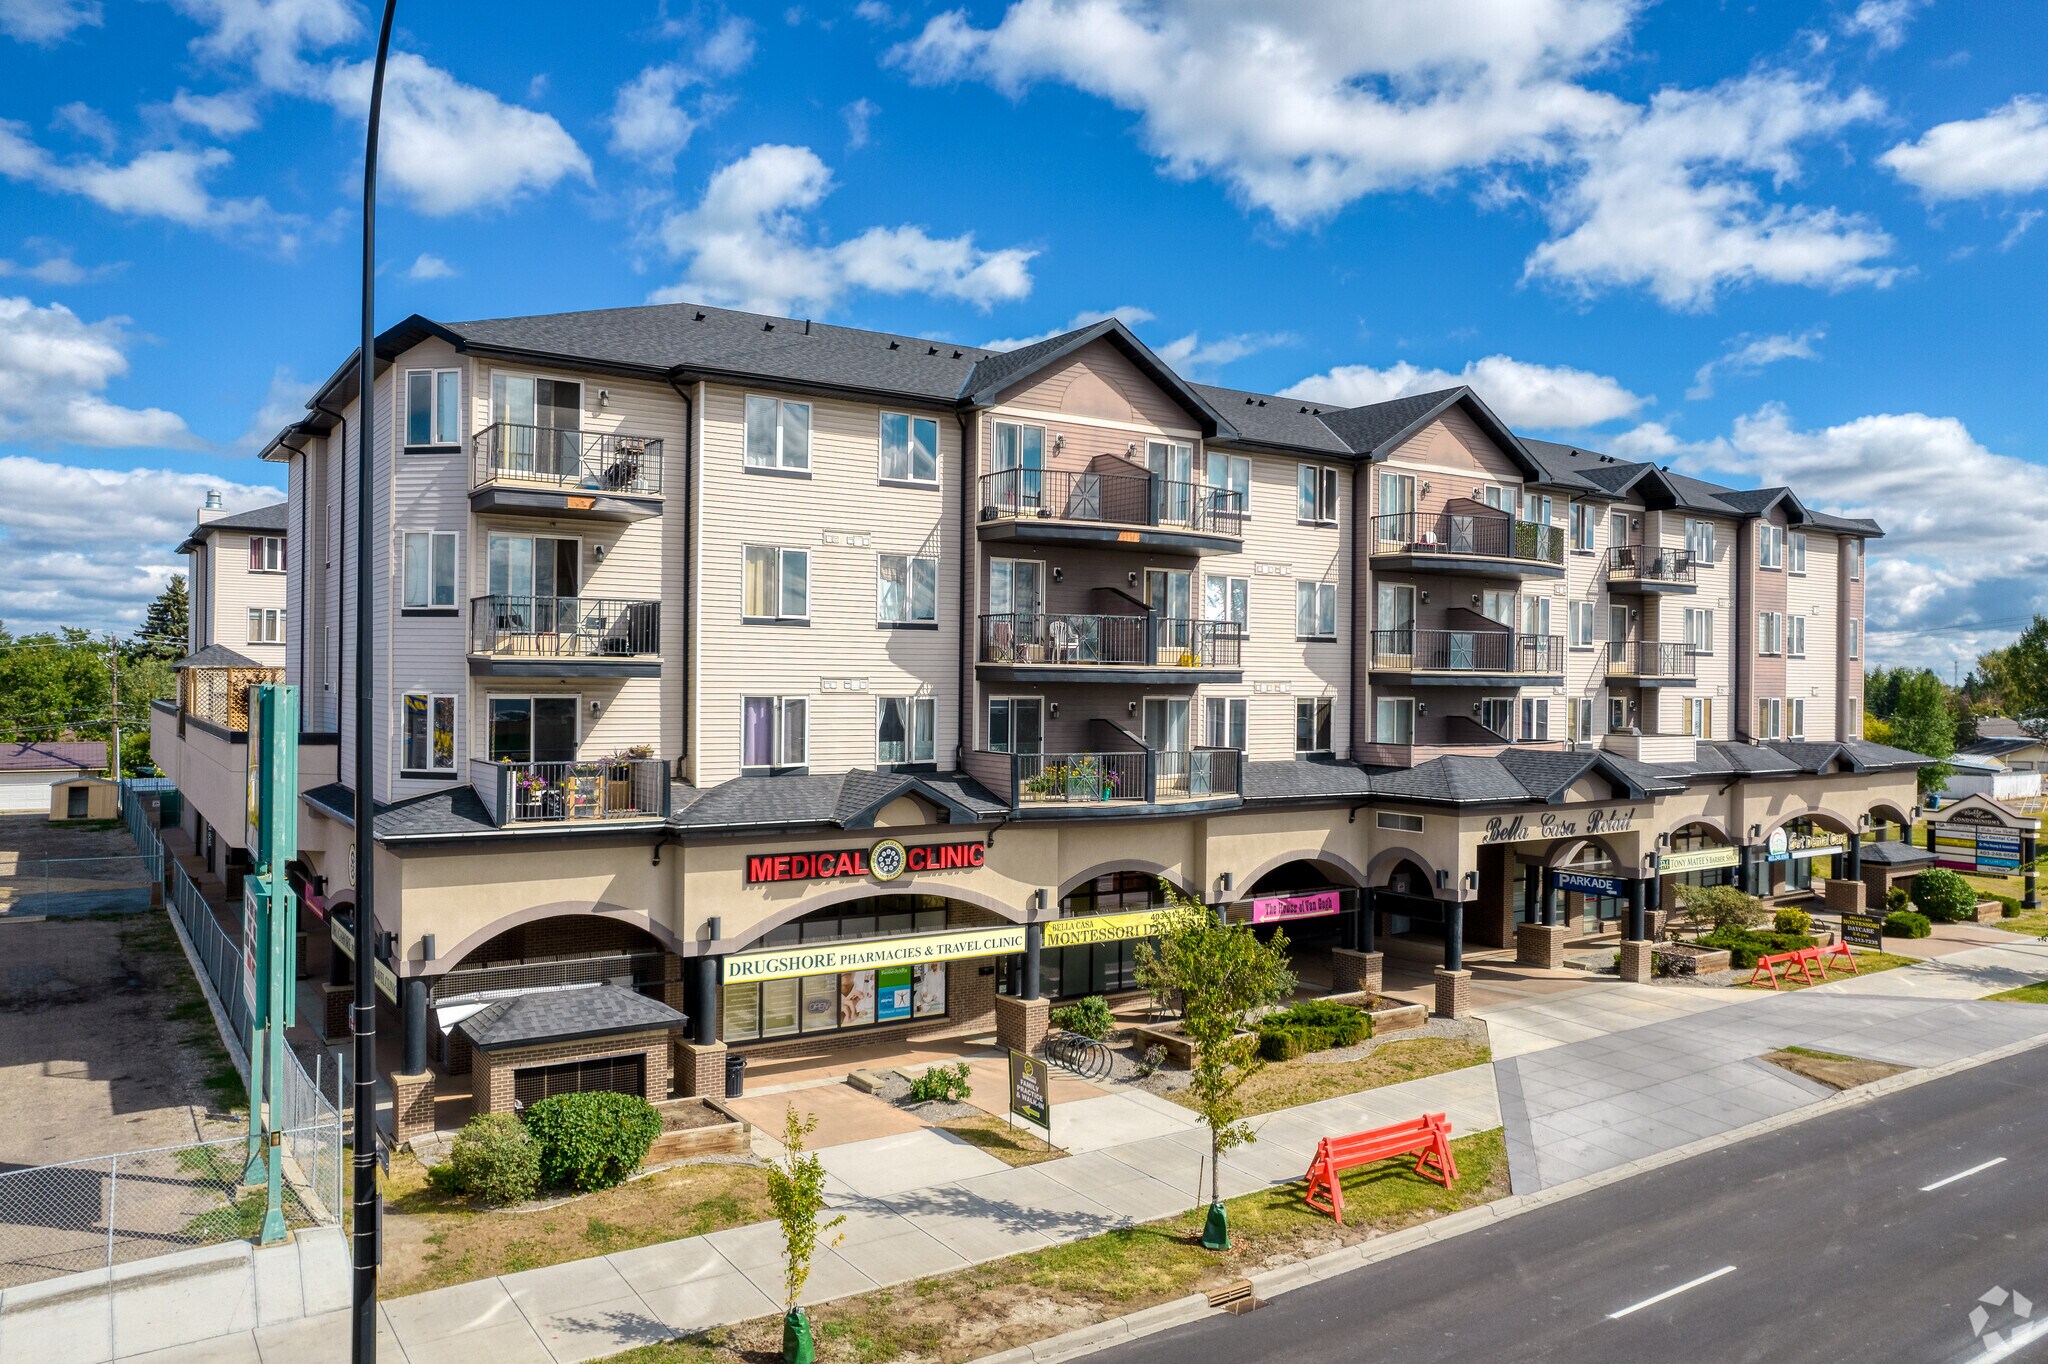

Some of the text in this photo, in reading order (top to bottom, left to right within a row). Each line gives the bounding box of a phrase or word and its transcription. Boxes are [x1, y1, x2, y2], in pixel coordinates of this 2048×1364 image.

[1482, 807, 1636, 843] Bella Casa Retail
[1953, 817, 2000, 825] CONDOMINIUMS
[1805, 833, 1830, 849] Dental
[1830, 833, 1847, 846] Care
[750, 852, 869, 881] MEDICAL
[907, 843, 984, 871] CLINIC
[1671, 858, 1686, 868] TONY
[1559, 873, 1613, 890] PARKADE
[1265, 897, 1333, 915] The House of Van Gogh
[1052, 921, 1075, 932] BELLA
[1076, 920, 1094, 930] CASA
[1843, 919, 1880, 929] MONTESSORI
[1847, 925, 1875, 934] DAYCARE
[1047, 924, 1139, 946] MONTESSORI
[729, 936, 1023, 977] DRUGSHORE PHARMACIES & TRAVEL CLINIC
[809, 1001, 830, 1011] OPEN
[1017, 1085, 1043, 1102] PRACTICE
[1020, 1078, 1039, 1093] FAMILY
[1022, 1093, 1044, 1110] WALK-IN
